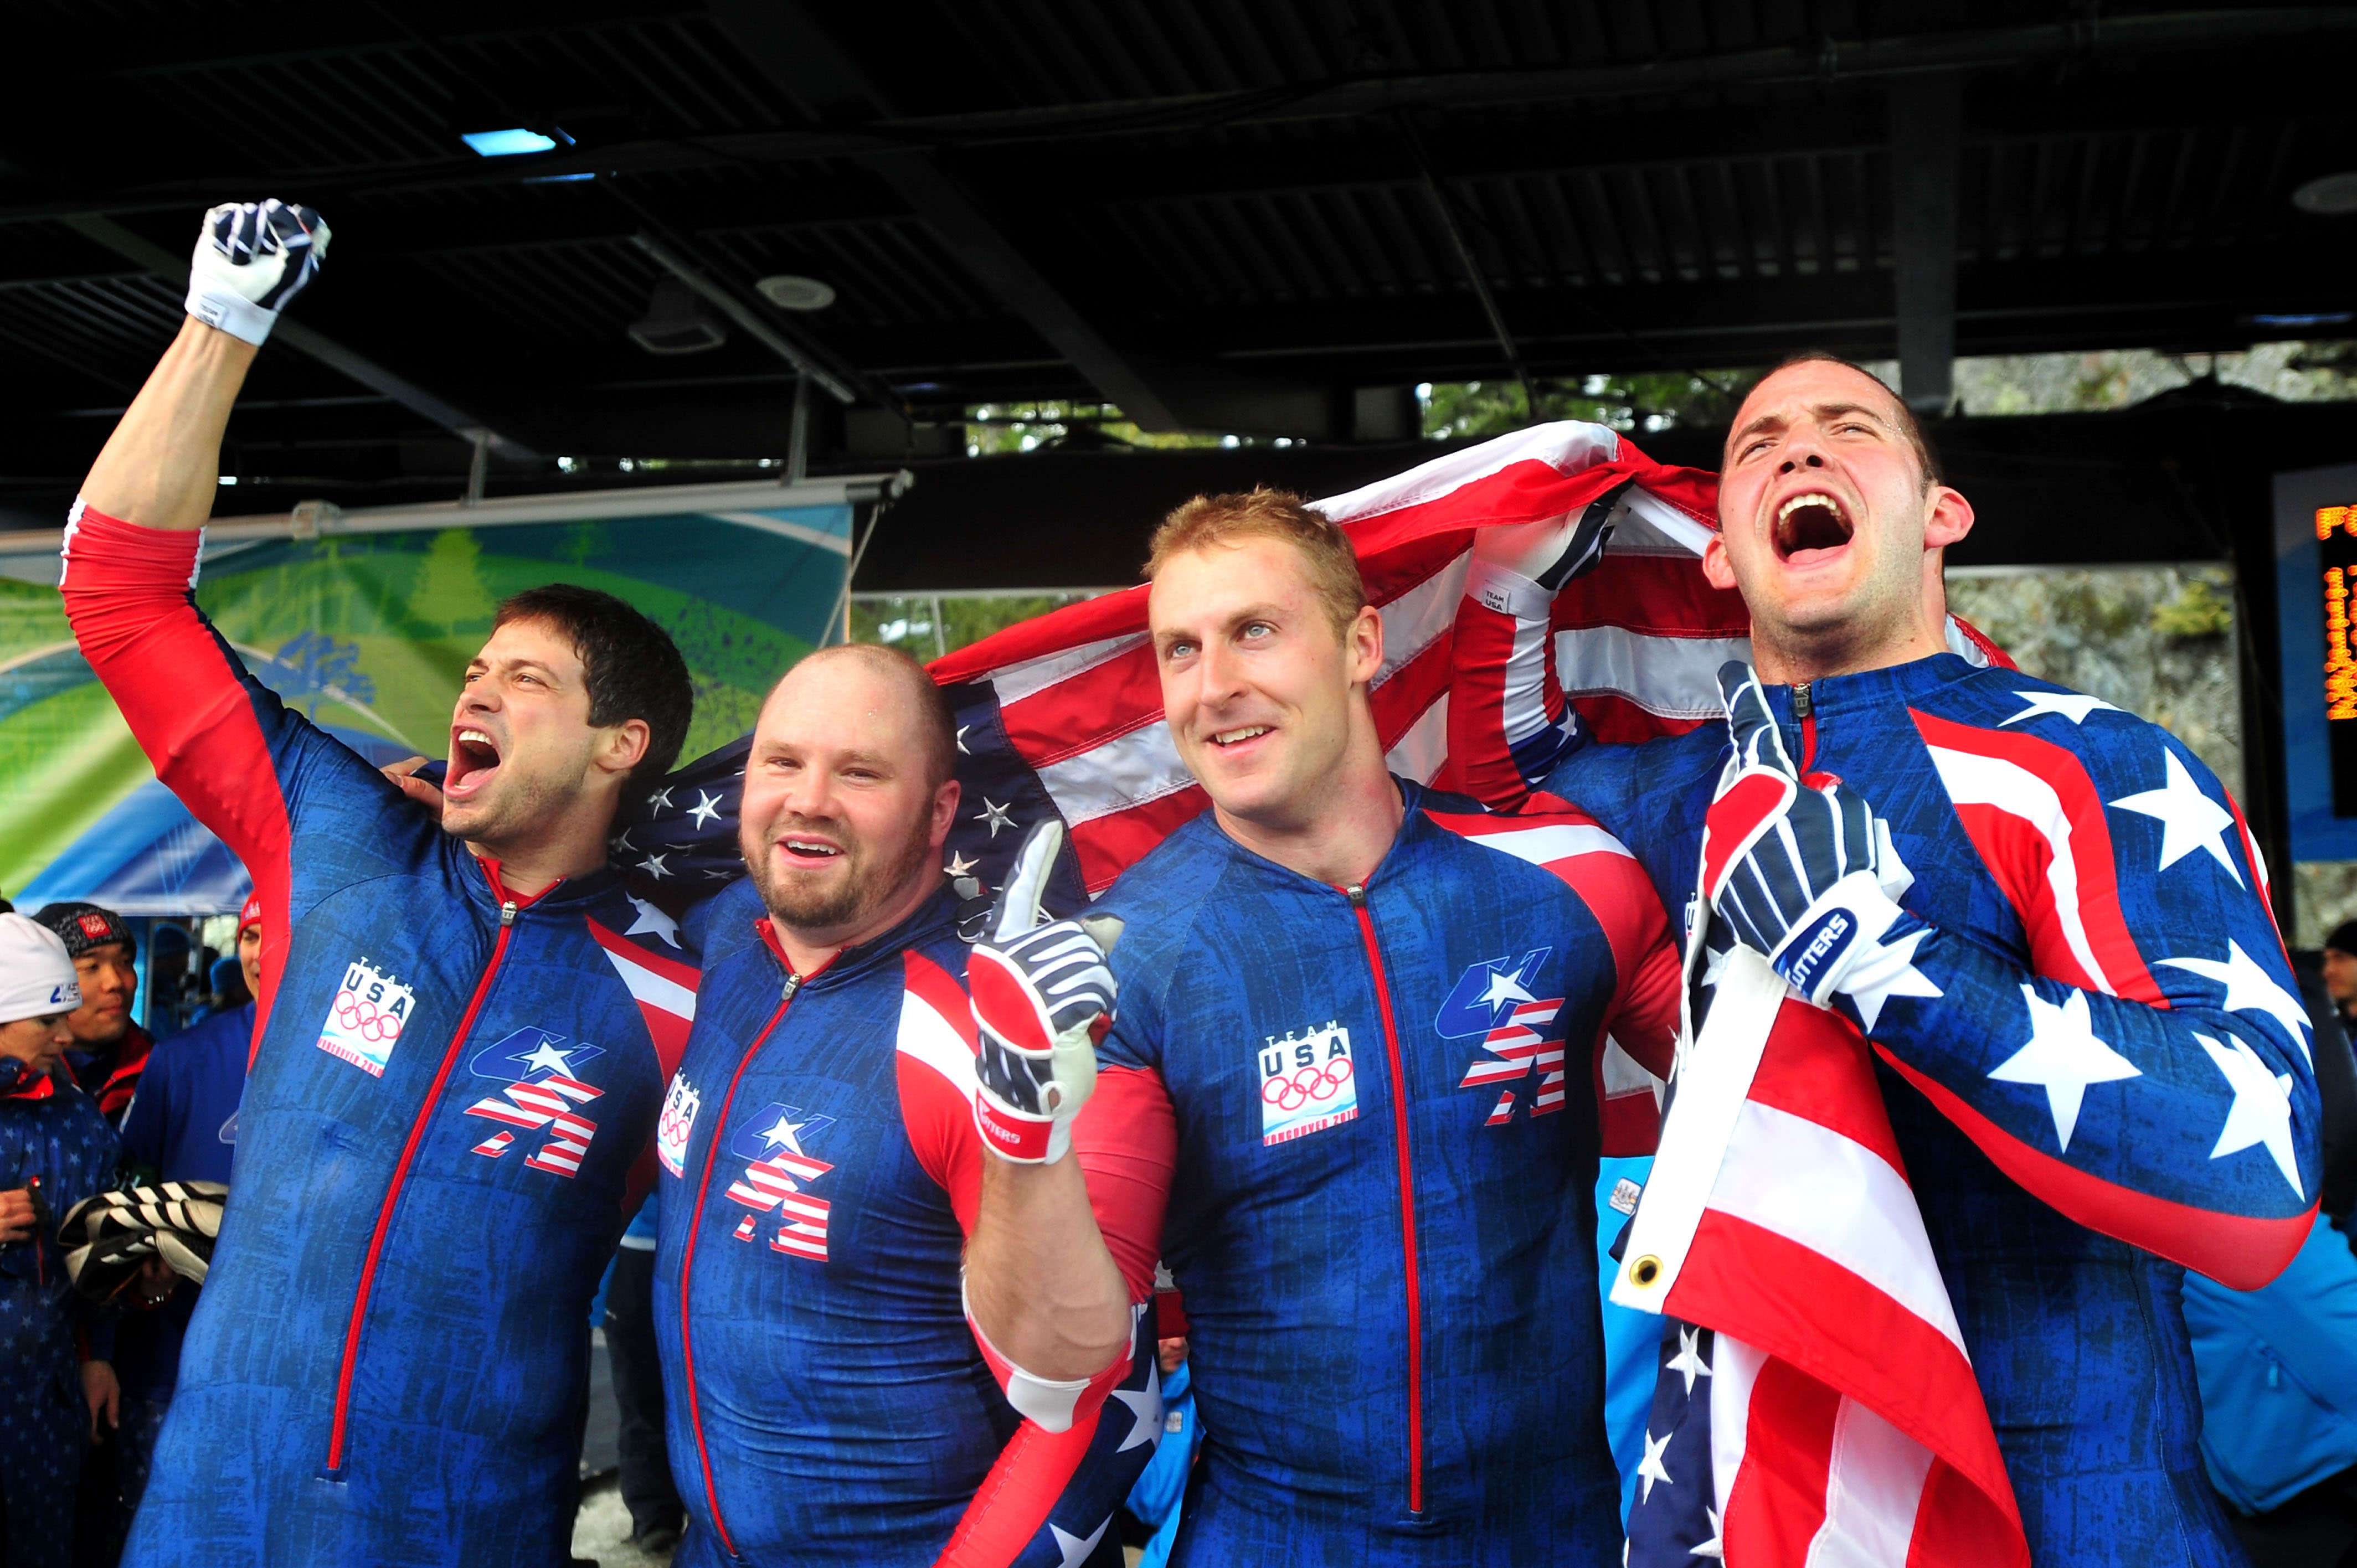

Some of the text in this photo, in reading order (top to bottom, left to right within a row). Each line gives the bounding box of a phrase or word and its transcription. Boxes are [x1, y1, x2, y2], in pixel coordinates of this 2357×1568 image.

[1485, 599, 1502, 611] USA
[1486, 590, 1504, 603] TEAM
[346, 969, 406, 1020] USA
[361, 956, 413, 996] TEAM
[1265, 1020, 1338, 1048] TEAM
[316, 1038, 384, 1078] VANCOUVER 2010
[1264, 1035, 1347, 1077] USA
[1263, 1107, 1359, 1146] VANCOUVER 2010
